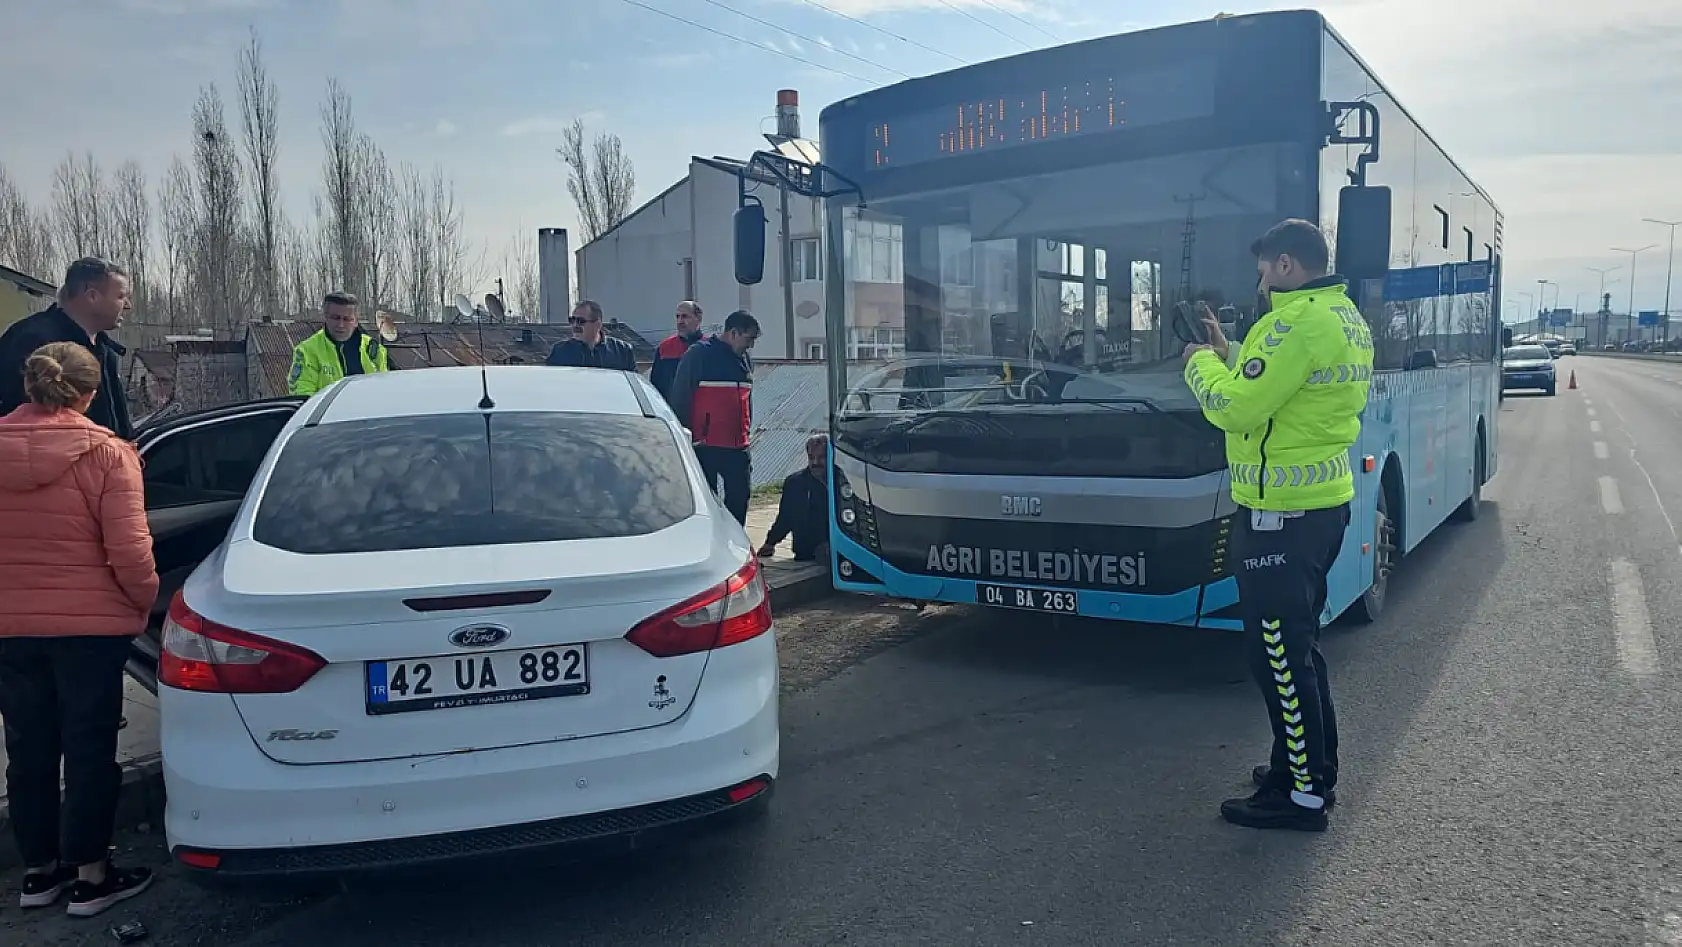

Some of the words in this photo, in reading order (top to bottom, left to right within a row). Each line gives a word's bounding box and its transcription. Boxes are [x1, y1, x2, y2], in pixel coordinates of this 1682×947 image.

[1001, 495, 1042, 516] BMC
[926, 543, 981, 575] AĞRI
[990, 548, 1147, 586] BELEDİYESİ
[985, 586, 1003, 604] 04
[1015, 590, 1034, 607] BA
[1043, 591, 1075, 611] 263
[372, 685, 386, 696] TR
[390, 663, 433, 696] 42
[455, 656, 497, 691] UA
[519, 650, 581, 685] 882
